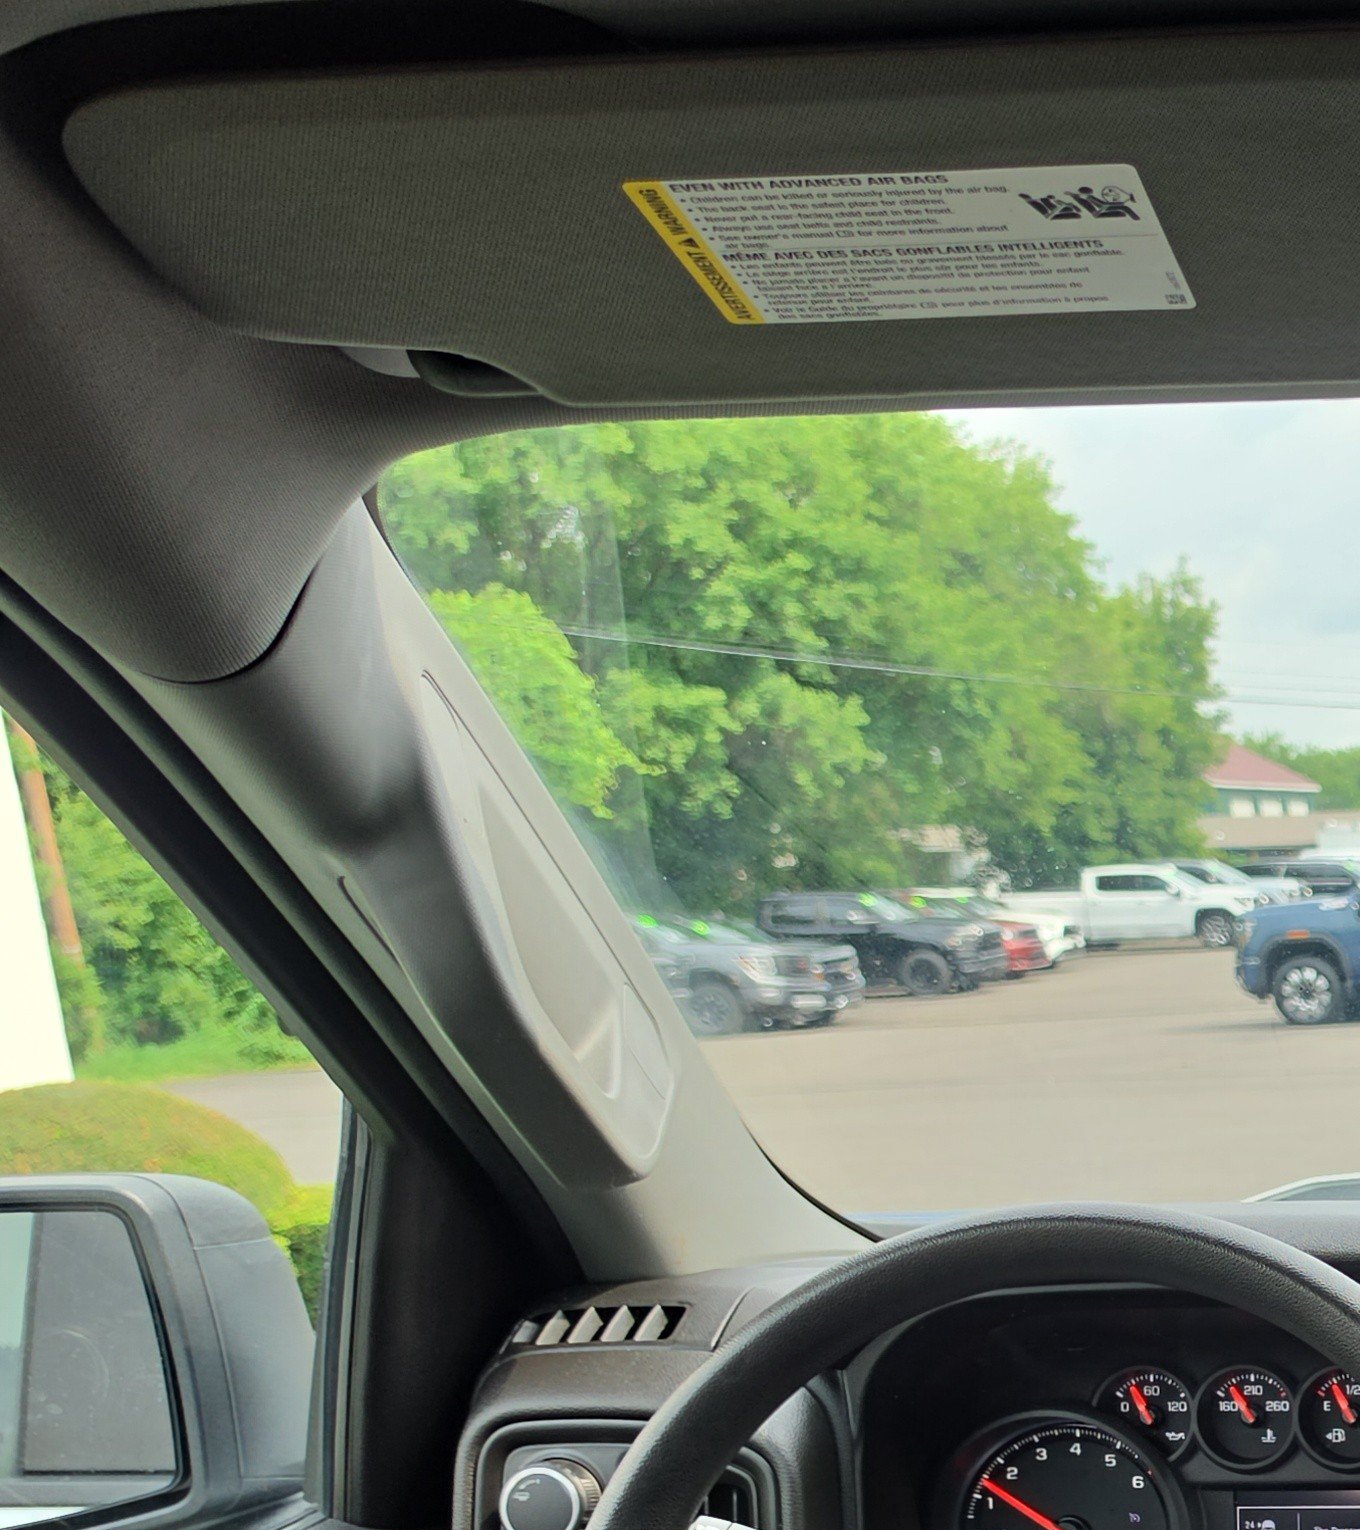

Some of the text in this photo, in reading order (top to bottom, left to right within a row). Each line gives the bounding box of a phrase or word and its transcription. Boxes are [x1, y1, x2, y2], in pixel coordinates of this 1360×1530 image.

[665, 173, 950, 193] EVEN WITH ADVANCED AIR BAGS
[638, 188, 688, 236] WARNING
[719, 240, 1105, 262] MÊME AVEC DES SACS GONFLABLES INTELLIGENTS
[686, 250, 757, 321] AVERTISSEMENT
[1144, 1386, 1159, 1396] 60
[1244, 1385, 1262, 1396] 210
[1346, 1385, 1360, 1395] 1/2
[1120, 1402, 1129, 1412] 0
[1167, 1402, 1187, 1412] 120
[1219, 1402, 1238, 1412] 160
[1265, 1401, 1289, 1412] 260
[1323, 1402, 1331, 1411] E
[1036, 1448, 1047, 1461] 3
[1070, 1443, 1081, 1456] 4
[1105, 1454, 1116, 1467] 5
[1006, 1467, 1018, 1480] 2
[1132, 1476, 1144, 1489] 6
[988, 1497, 993, 1509] 1
